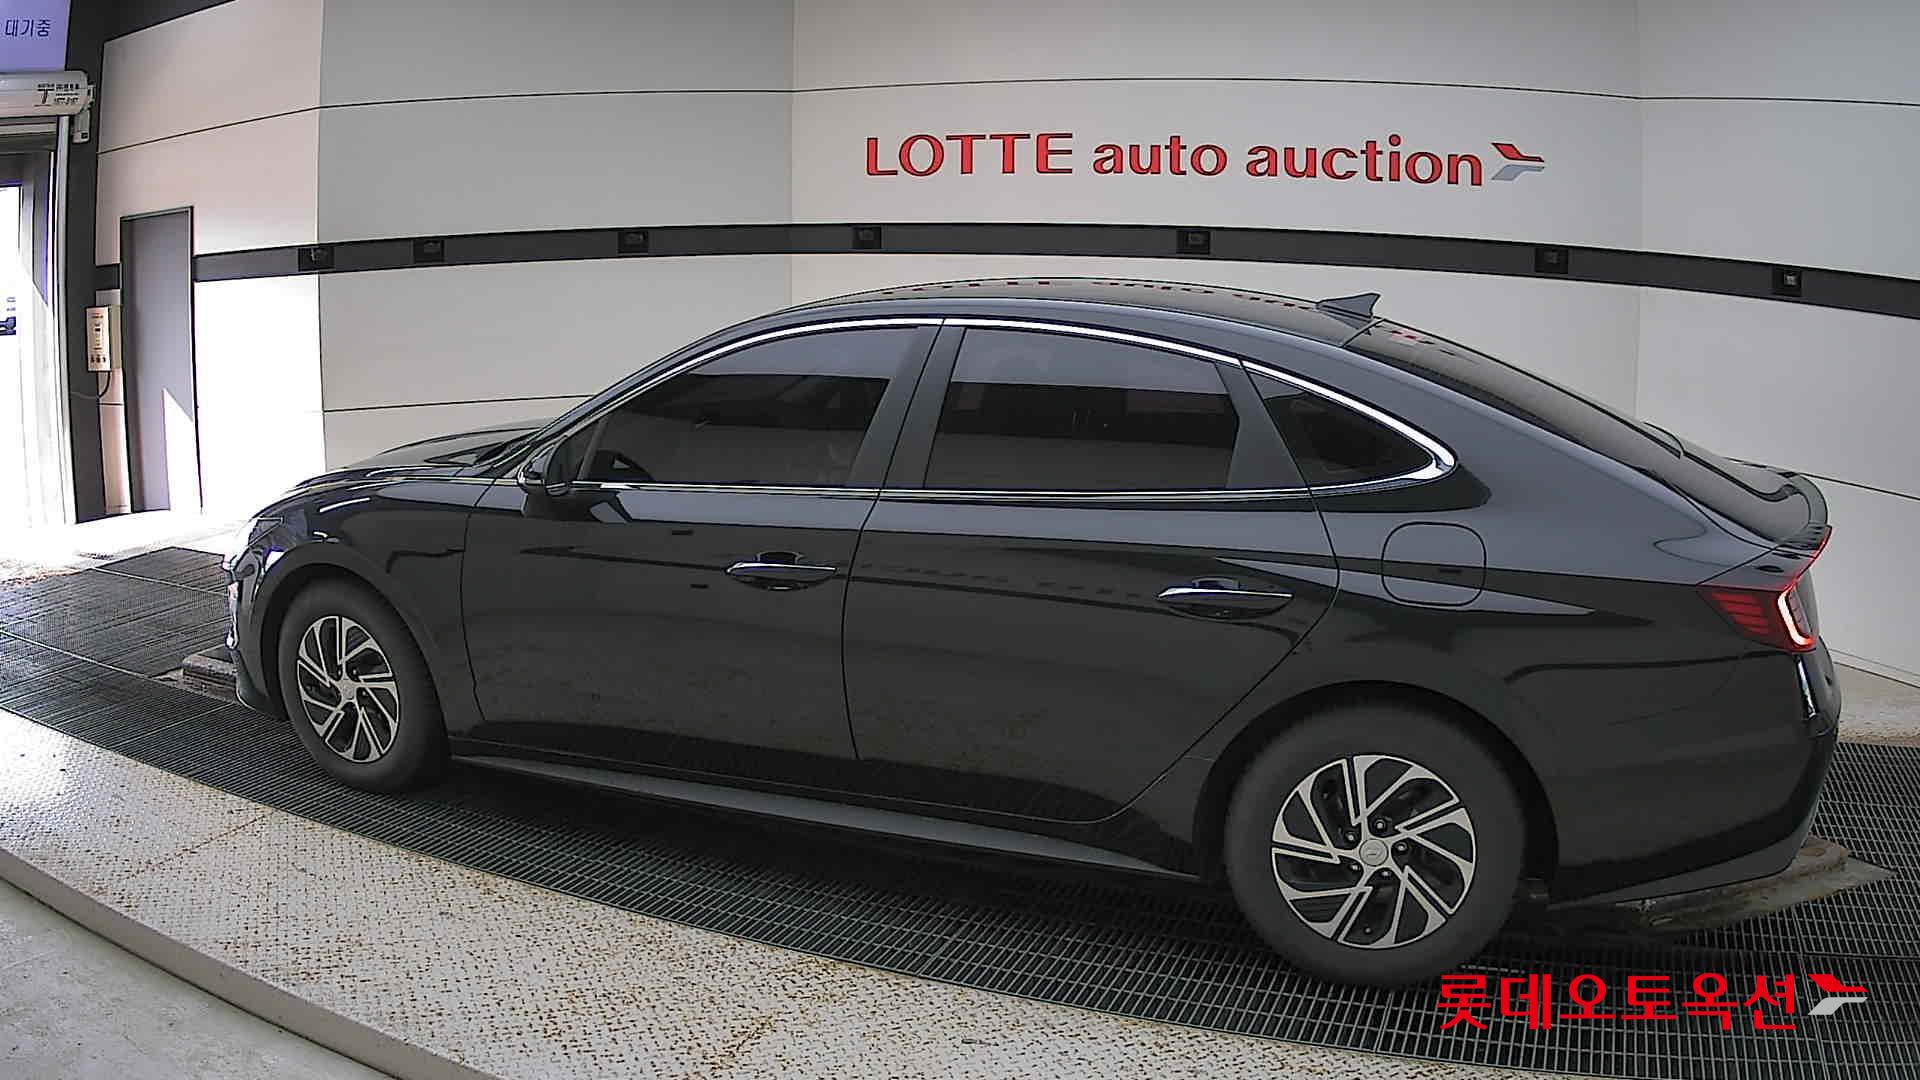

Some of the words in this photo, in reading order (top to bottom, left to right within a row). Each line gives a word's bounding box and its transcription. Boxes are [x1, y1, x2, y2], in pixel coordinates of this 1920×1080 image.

[4, 18, 51, 37] 대기중
[865, 133, 1073, 177] LOTTE
[1093, 135, 1227, 176] auto
[1246, 135, 1484, 186] auction
